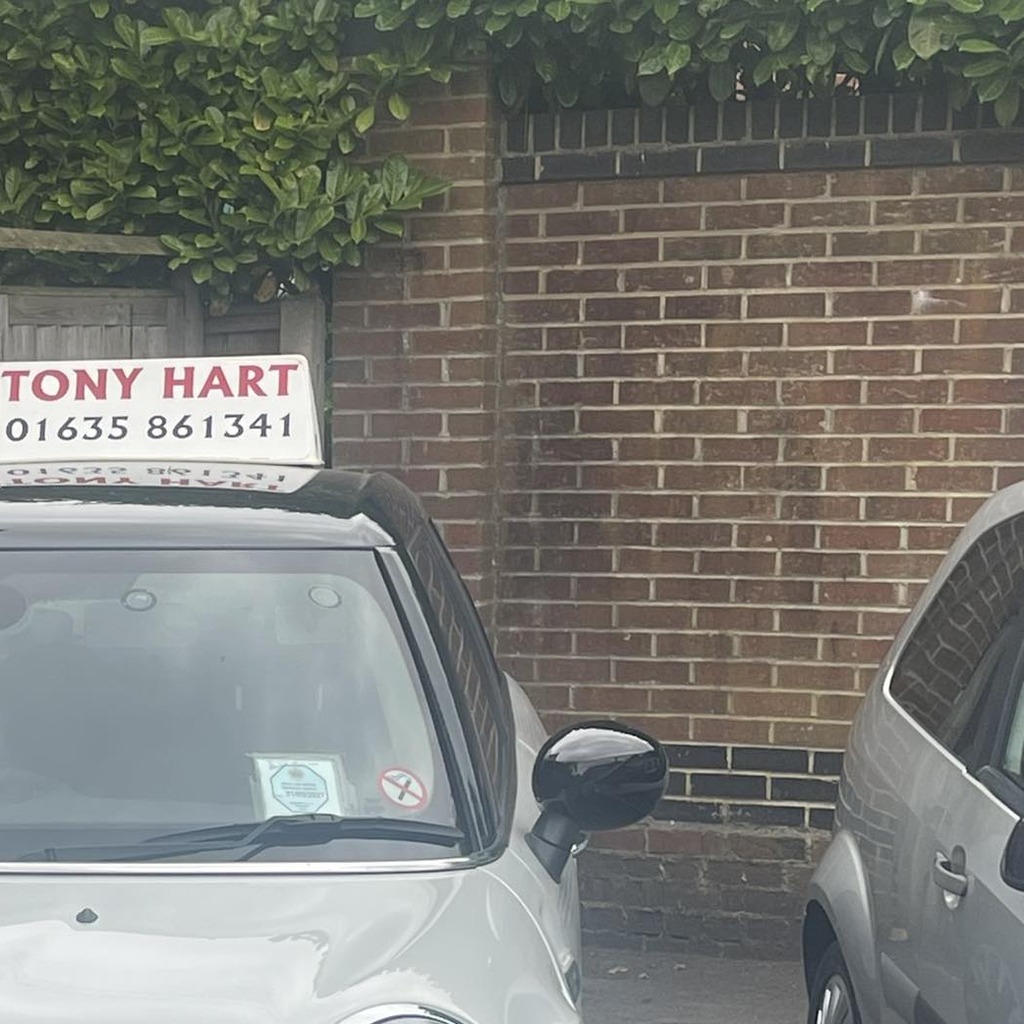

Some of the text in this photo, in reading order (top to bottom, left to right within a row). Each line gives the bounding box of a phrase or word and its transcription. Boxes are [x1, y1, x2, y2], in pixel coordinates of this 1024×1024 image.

[1, 364, 299, 402] TONY HART
[5, 412, 292, 442] 01635 861341
